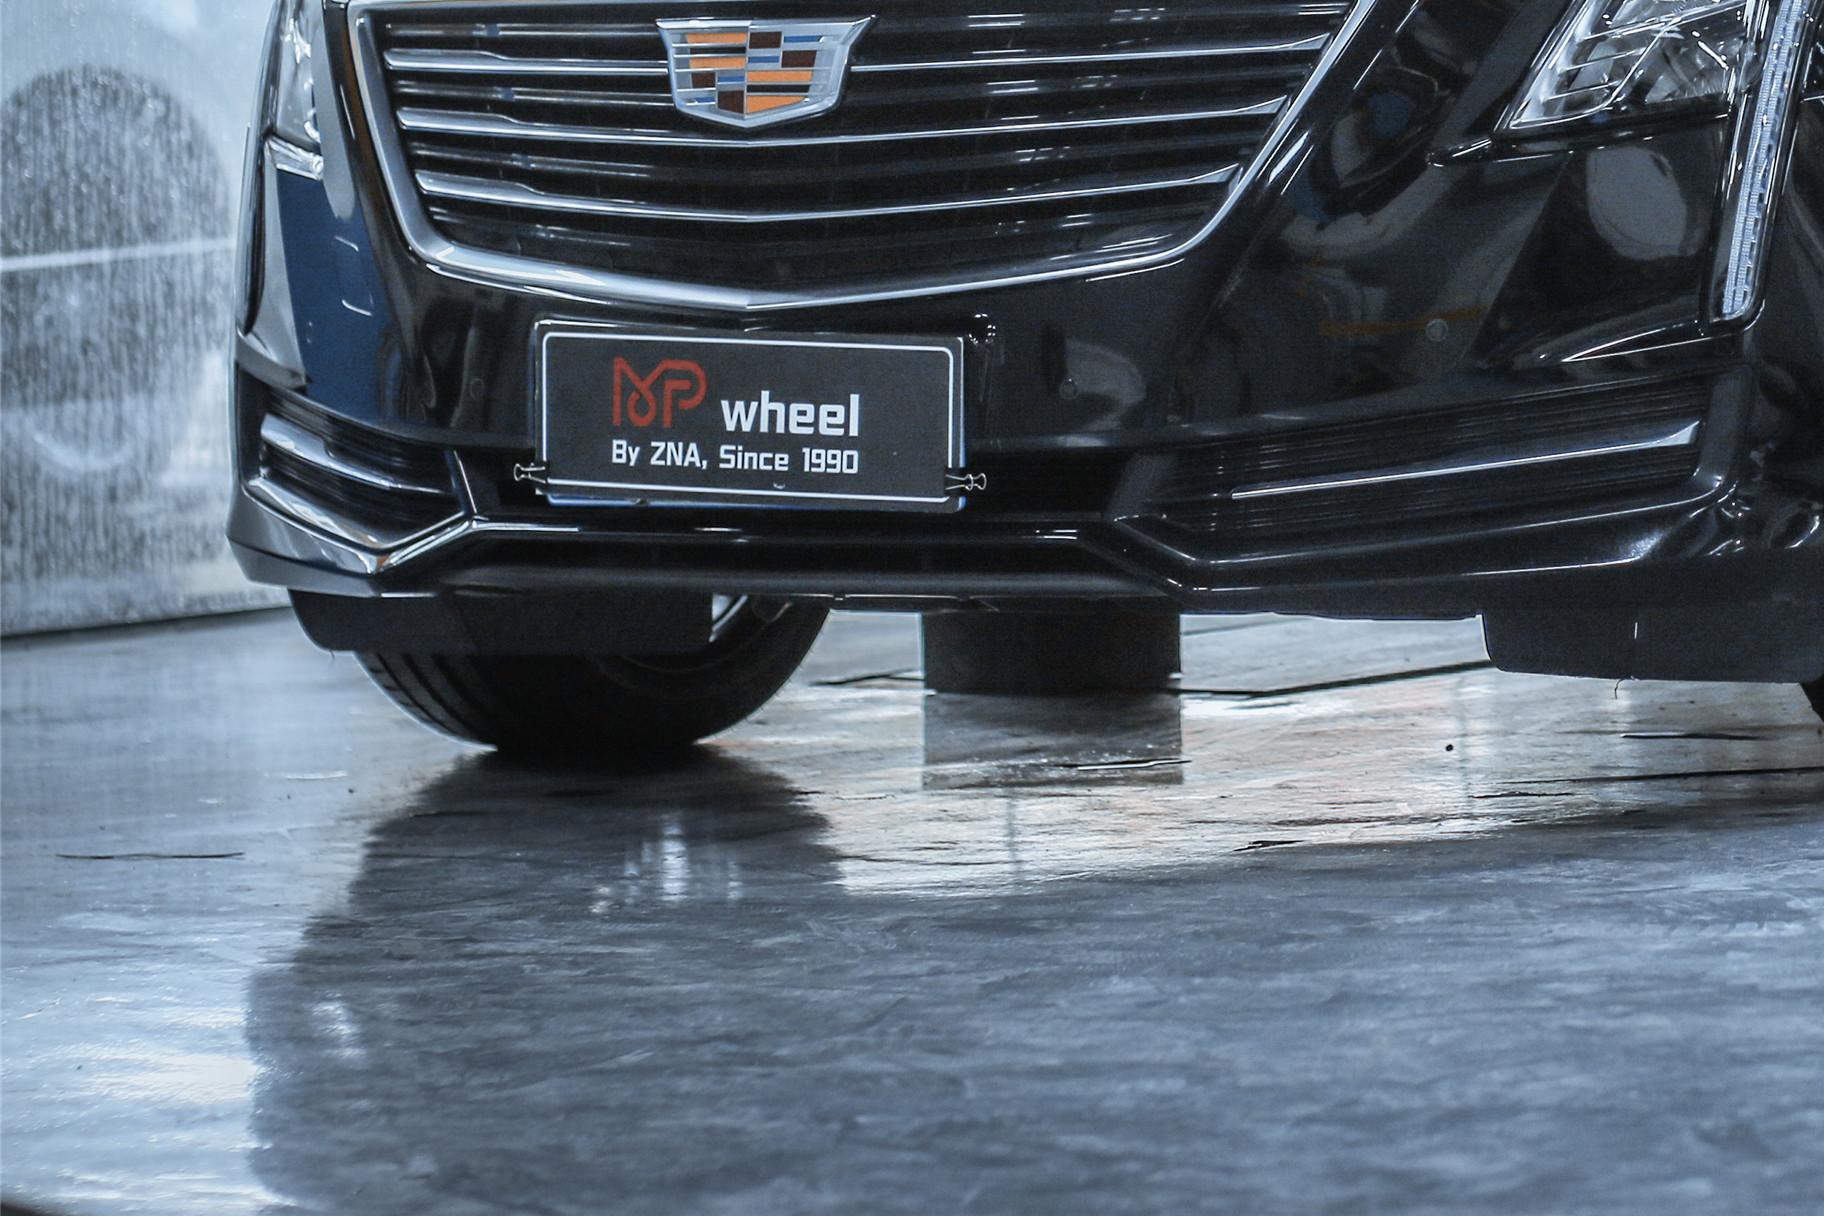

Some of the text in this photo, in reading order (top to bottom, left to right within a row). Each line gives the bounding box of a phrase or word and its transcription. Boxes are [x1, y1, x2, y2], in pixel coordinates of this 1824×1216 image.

[720, 389, 860, 438] wheel
[611, 439, 859, 474] By ZNA, Since 1990
